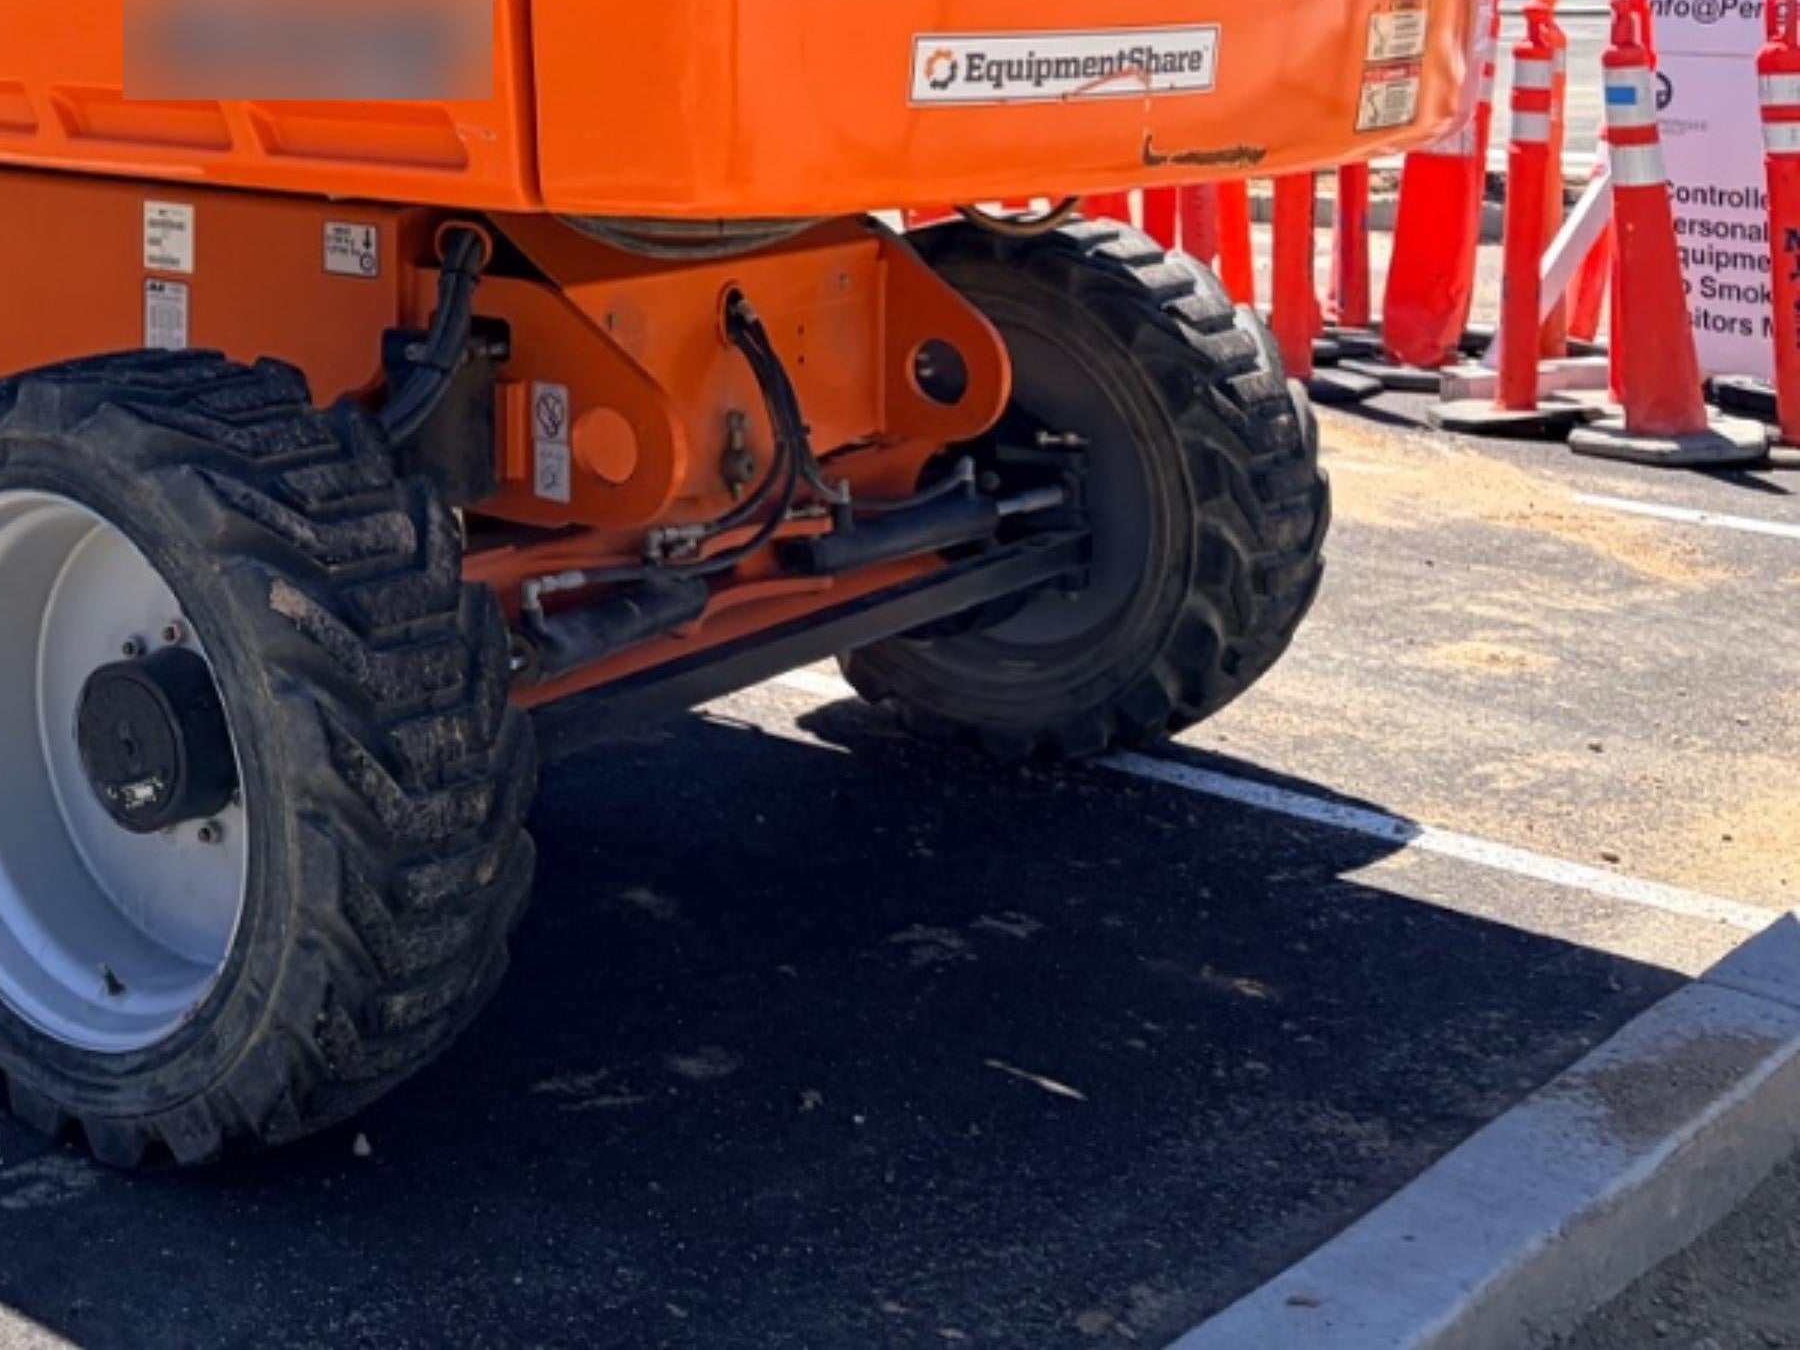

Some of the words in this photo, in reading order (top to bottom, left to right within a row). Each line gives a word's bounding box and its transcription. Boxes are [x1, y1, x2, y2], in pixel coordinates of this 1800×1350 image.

[964, 46, 1203, 89] EquipmentShare
[1673, 216, 1769, 243] ersonal
[1678, 244, 1771, 273] quipme
[1699, 275, 1772, 305] Smok
